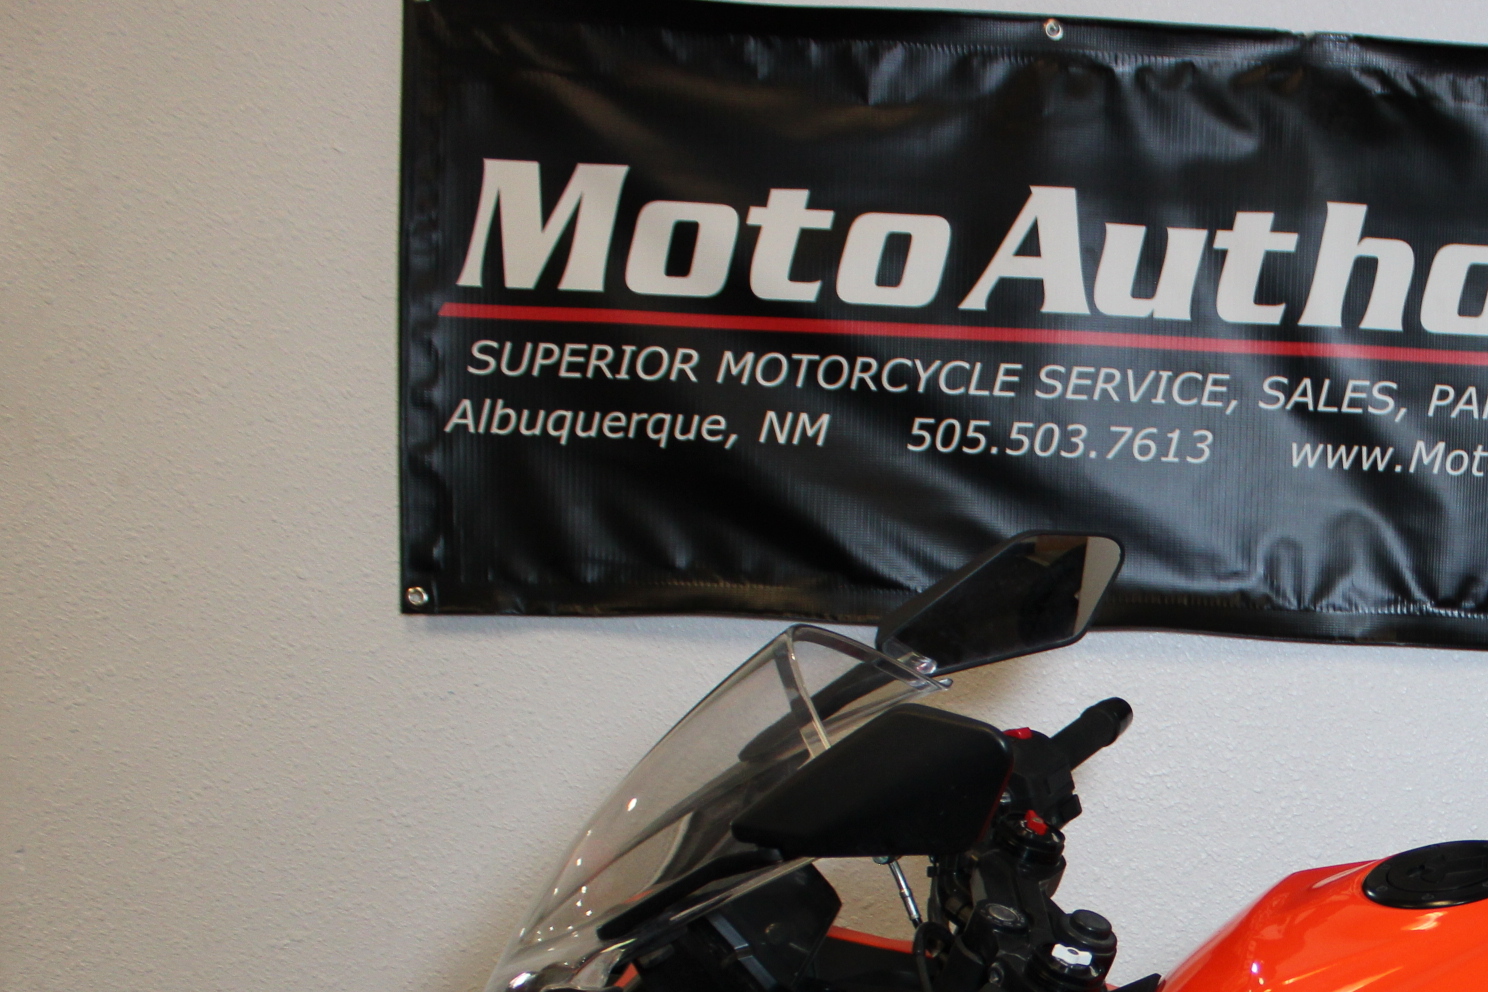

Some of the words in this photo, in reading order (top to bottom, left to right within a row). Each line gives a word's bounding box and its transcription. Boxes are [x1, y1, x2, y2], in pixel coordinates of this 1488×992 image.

[456, 157, 952, 308] Moto
[466, 339, 700, 383] SUPERIOR
[715, 350, 1023, 398] MOTORCYCLE
[1034, 364, 1238, 415] SERVICE,
[1258, 375, 1408, 424] SALES,
[443, 398, 739, 450] Albuquerque,
[758, 410, 832, 447] NM
[906, 417, 1214, 464] 505.503.7613
